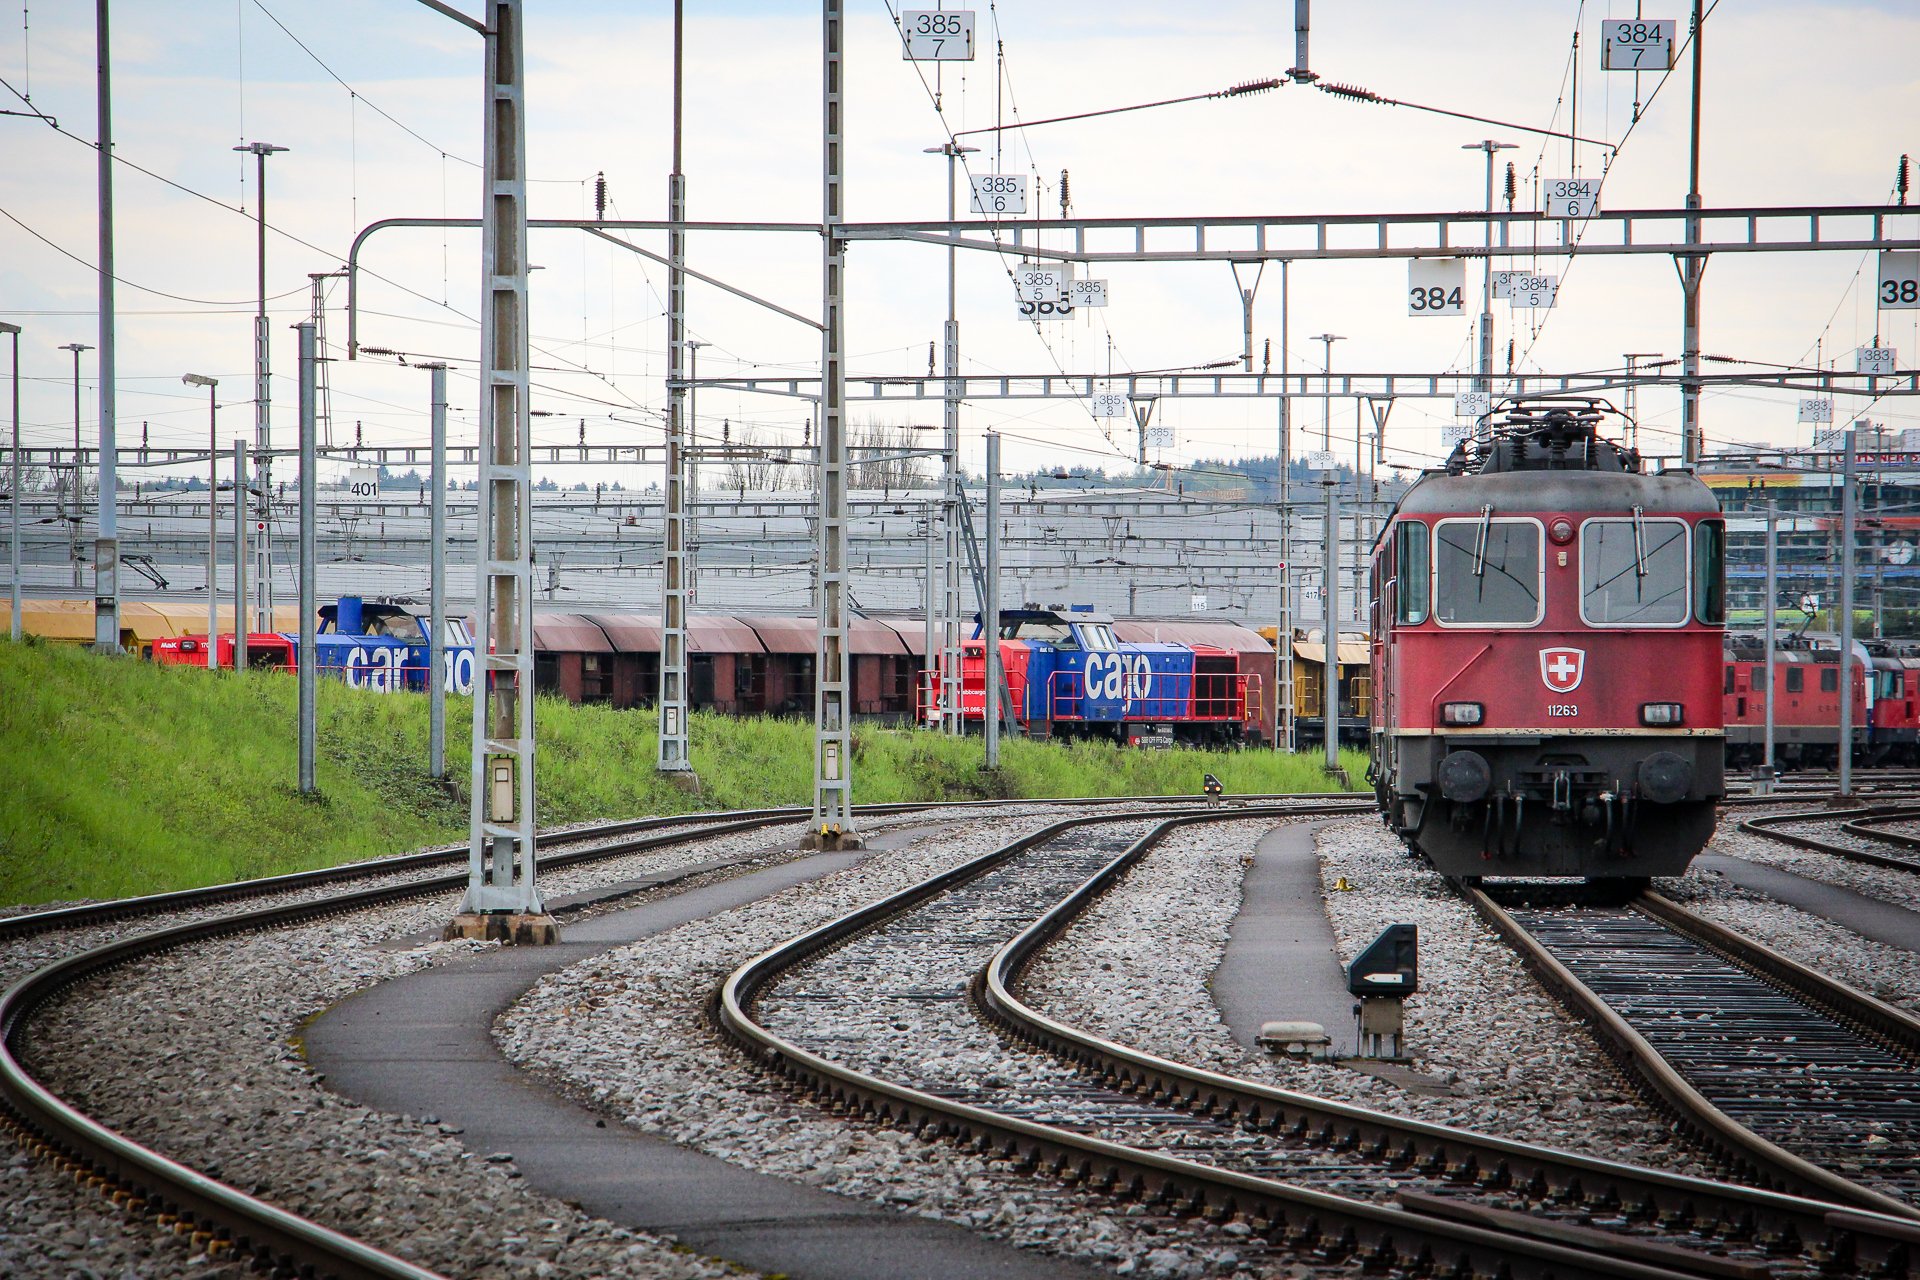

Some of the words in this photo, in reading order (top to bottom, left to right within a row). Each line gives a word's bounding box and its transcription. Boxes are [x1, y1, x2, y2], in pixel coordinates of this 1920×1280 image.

[916, 15, 961, 34] 385
[1617, 23, 1662, 44] 384
[933, 39, 945, 58] 7
[1631, 48, 1645, 68] 7
[981, 177, 1017, 193] 385
[1555, 181, 1591, 198] 384
[994, 196, 1006, 212] 6
[1567, 200, 1580, 217] 6
[1024, 272, 1053, 286] 385
[1520, 277, 1549, 291] 384
[1076, 281, 1101, 293] 385
[1881, 279, 1920, 304] 38
[1033, 287, 1043, 301] 5
[1084, 294, 1092, 305] 4
[1410, 286, 1464, 310] 384
[1529, 293, 1539, 306] 5
[1864, 350, 1890, 361] 383
[1871, 363, 1880, 373] 4
[1100, 394, 1121, 405] 385
[1462, 394, 1483, 404] 384
[1106, 405, 1114, 416] 3
[1469, 405, 1477, 415] 3
[1806, 401, 1828, 411] 383
[1813, 411, 1820, 421] 3
[1150, 427, 1169, 437] 385
[1448, 427, 1467, 436] 384
[1156, 437, 1163, 446] 2
[1827, 441, 1834, 450] 2
[1313, 452, 1331, 461] 385
[351, 482, 376, 496] 401
[1305, 590, 1318, 599] 417
[1547, 704, 1578, 716] 11263
